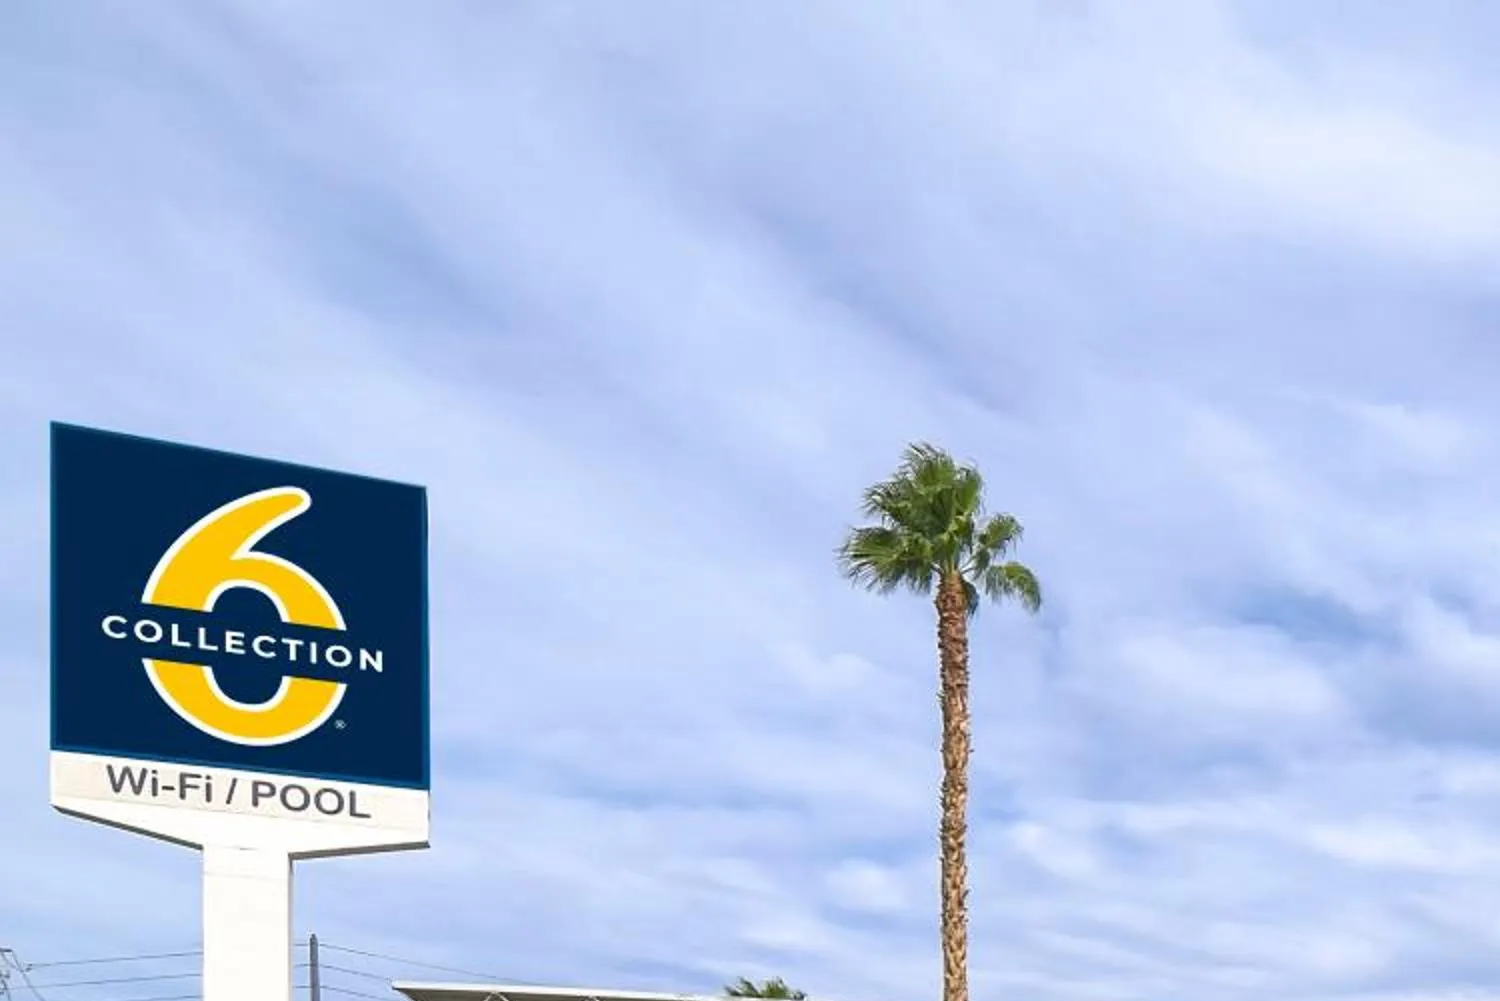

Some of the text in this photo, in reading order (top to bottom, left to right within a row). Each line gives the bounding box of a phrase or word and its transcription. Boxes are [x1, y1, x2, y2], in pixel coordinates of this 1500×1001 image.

[101, 614, 384, 674] COLLECTION
[141, 486, 347, 747] 6
[106, 764, 213, 803] Wi-Fi
[250, 780, 372, 819] POOL
